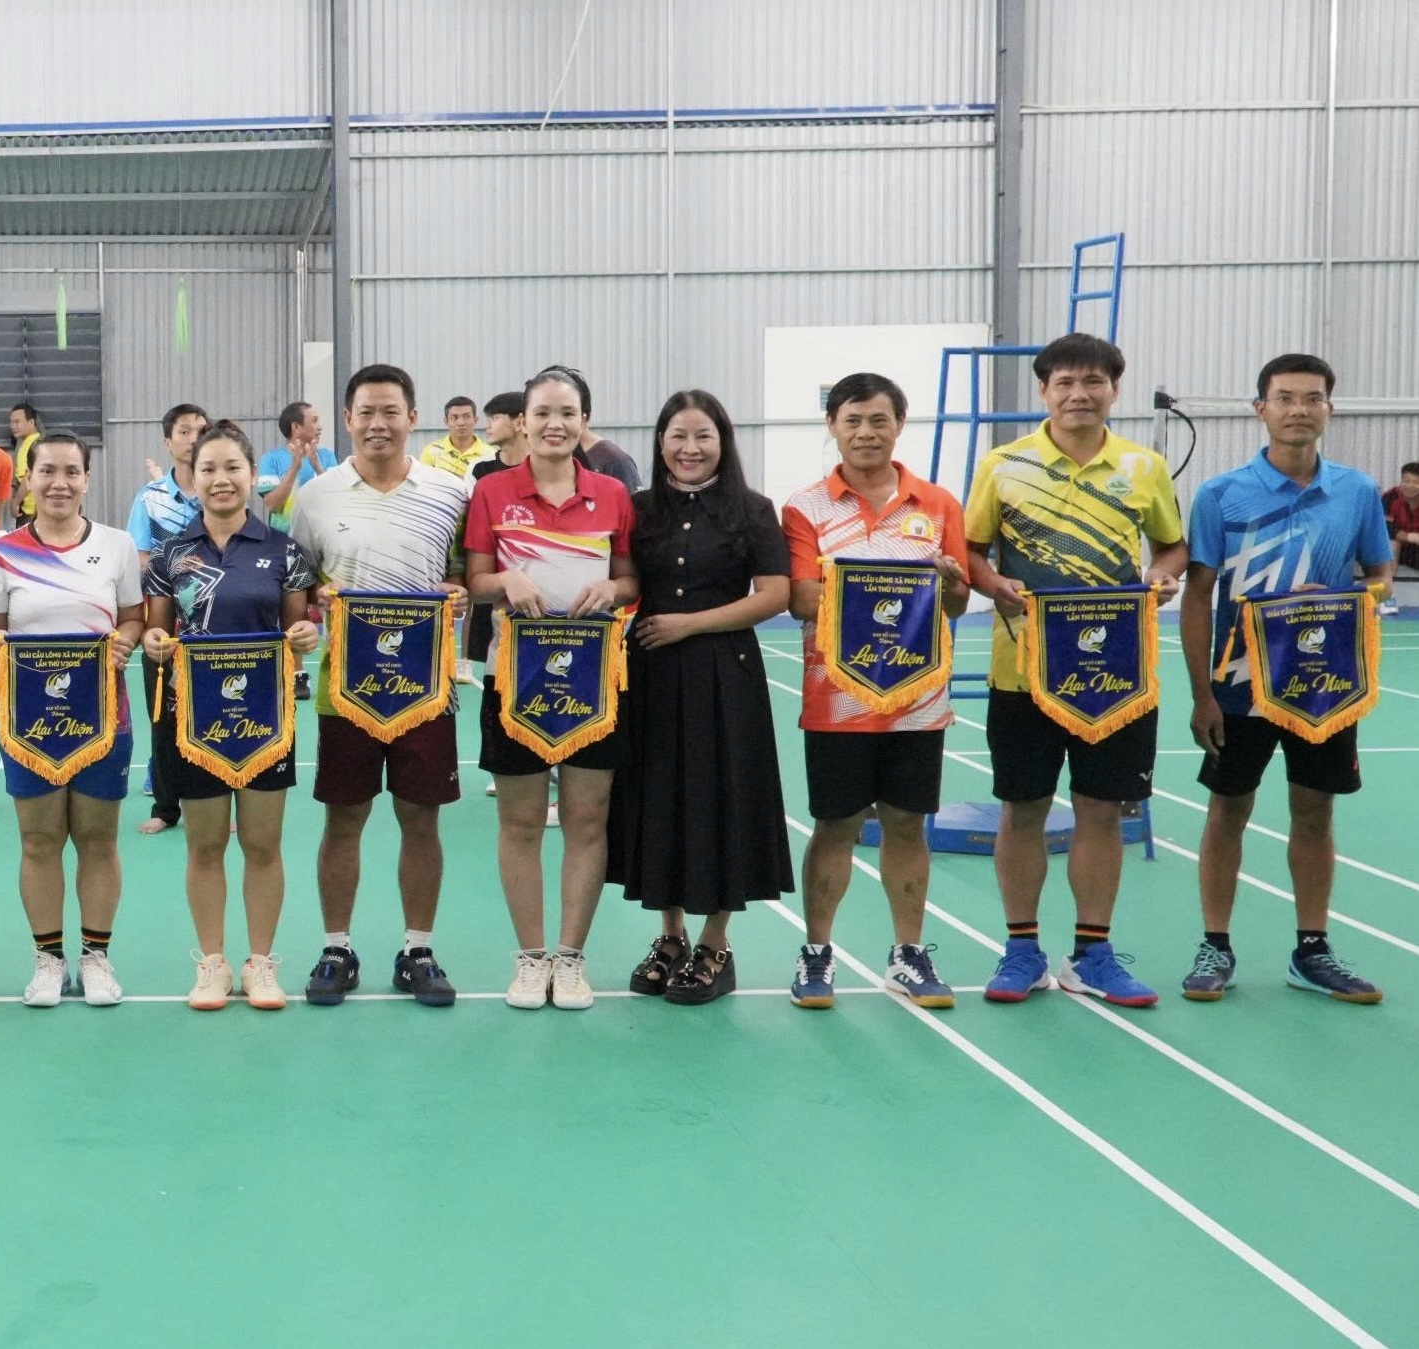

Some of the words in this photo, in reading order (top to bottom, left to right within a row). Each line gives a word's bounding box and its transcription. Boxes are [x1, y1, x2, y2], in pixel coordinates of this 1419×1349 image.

[419, 610, 431, 618] LỘC
[588, 630, 600, 638] LỘC
[83, 651, 96, 659] LỘC
[849, 644, 878, 667] Lưu
[883, 646, 925, 666] Niệm
[354, 675, 381, 696] Lưu
[385, 675, 424, 696] Niệm
[1056, 673, 1086, 696] Lưu
[1090, 672, 1132, 693] Niệm
[1282, 675, 1307, 698] Lưu
[1312, 673, 1352, 693] Niệm
[522, 695, 550, 717] Lưu
[554, 696, 592, 716] Niệm
[24, 718, 52, 740] Lưu
[55, 718, 93, 737] Niệm
[202, 721, 230, 743] Lưu
[234, 719, 272, 739] Niệm
